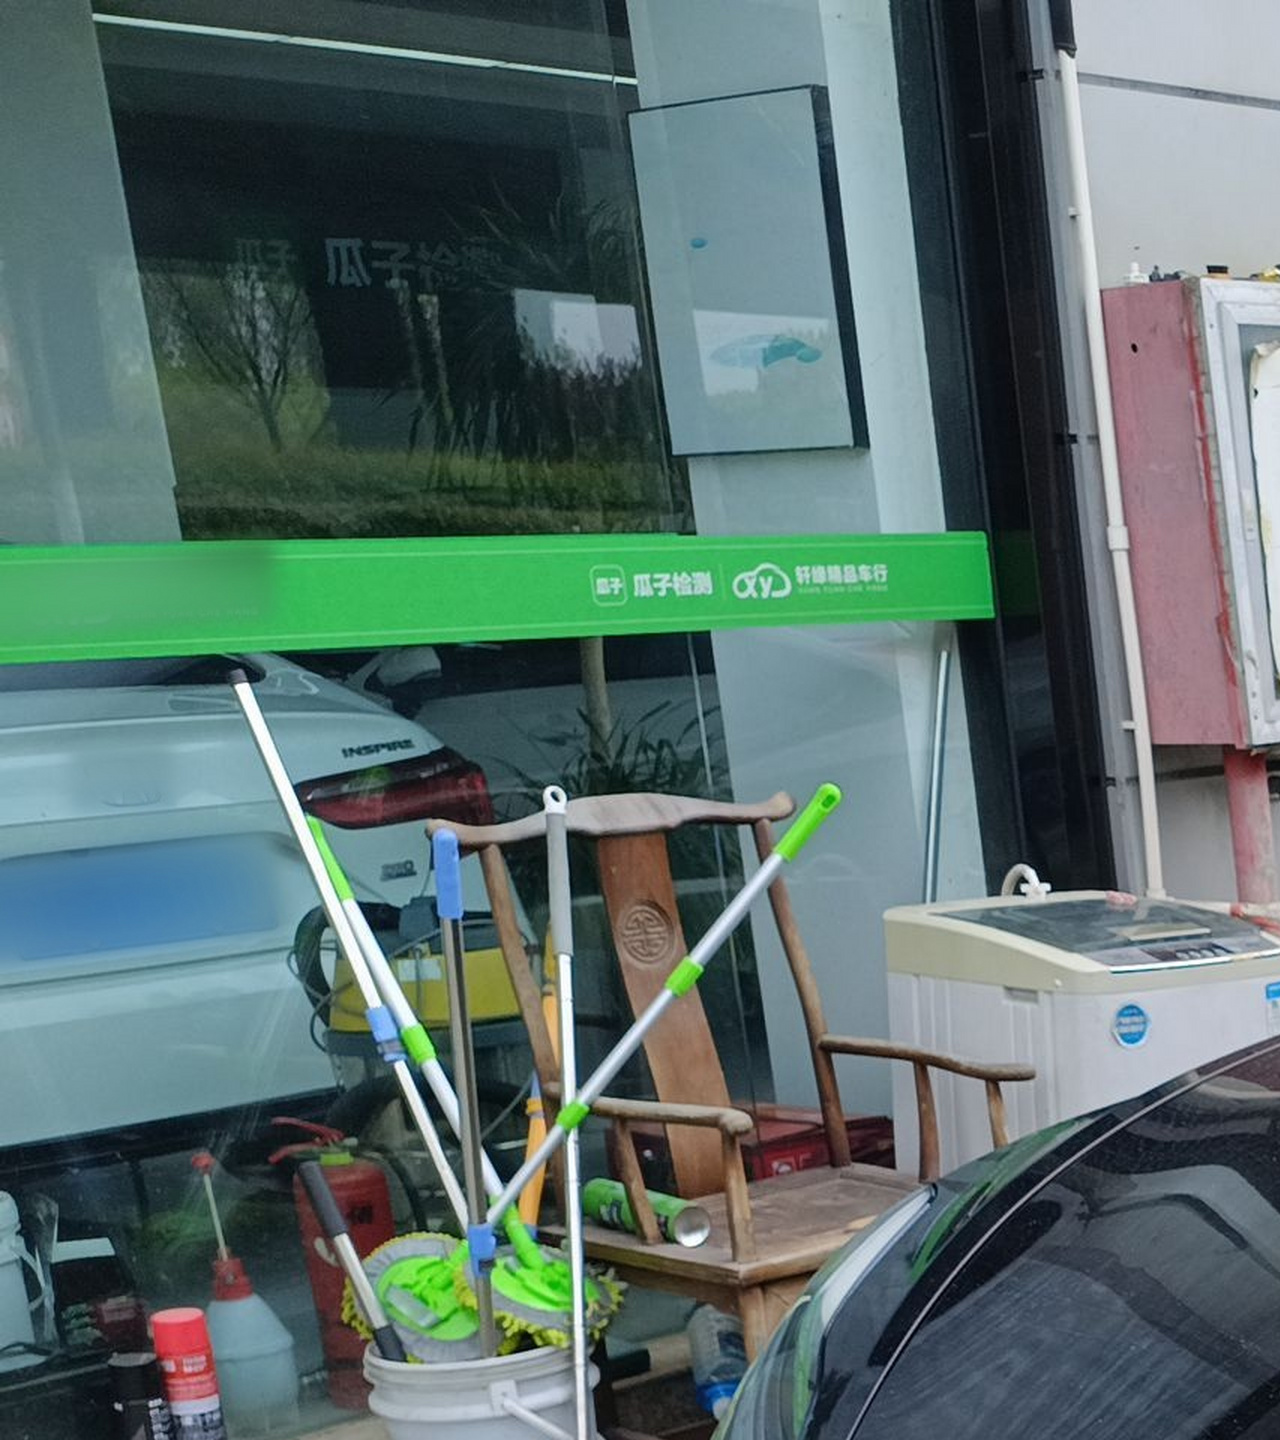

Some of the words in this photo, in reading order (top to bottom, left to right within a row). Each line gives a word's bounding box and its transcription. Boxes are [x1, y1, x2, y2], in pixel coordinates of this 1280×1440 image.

[633, 570, 713, 598] 瓜子检测
[341, 738, 415, 758] INSPIRE
